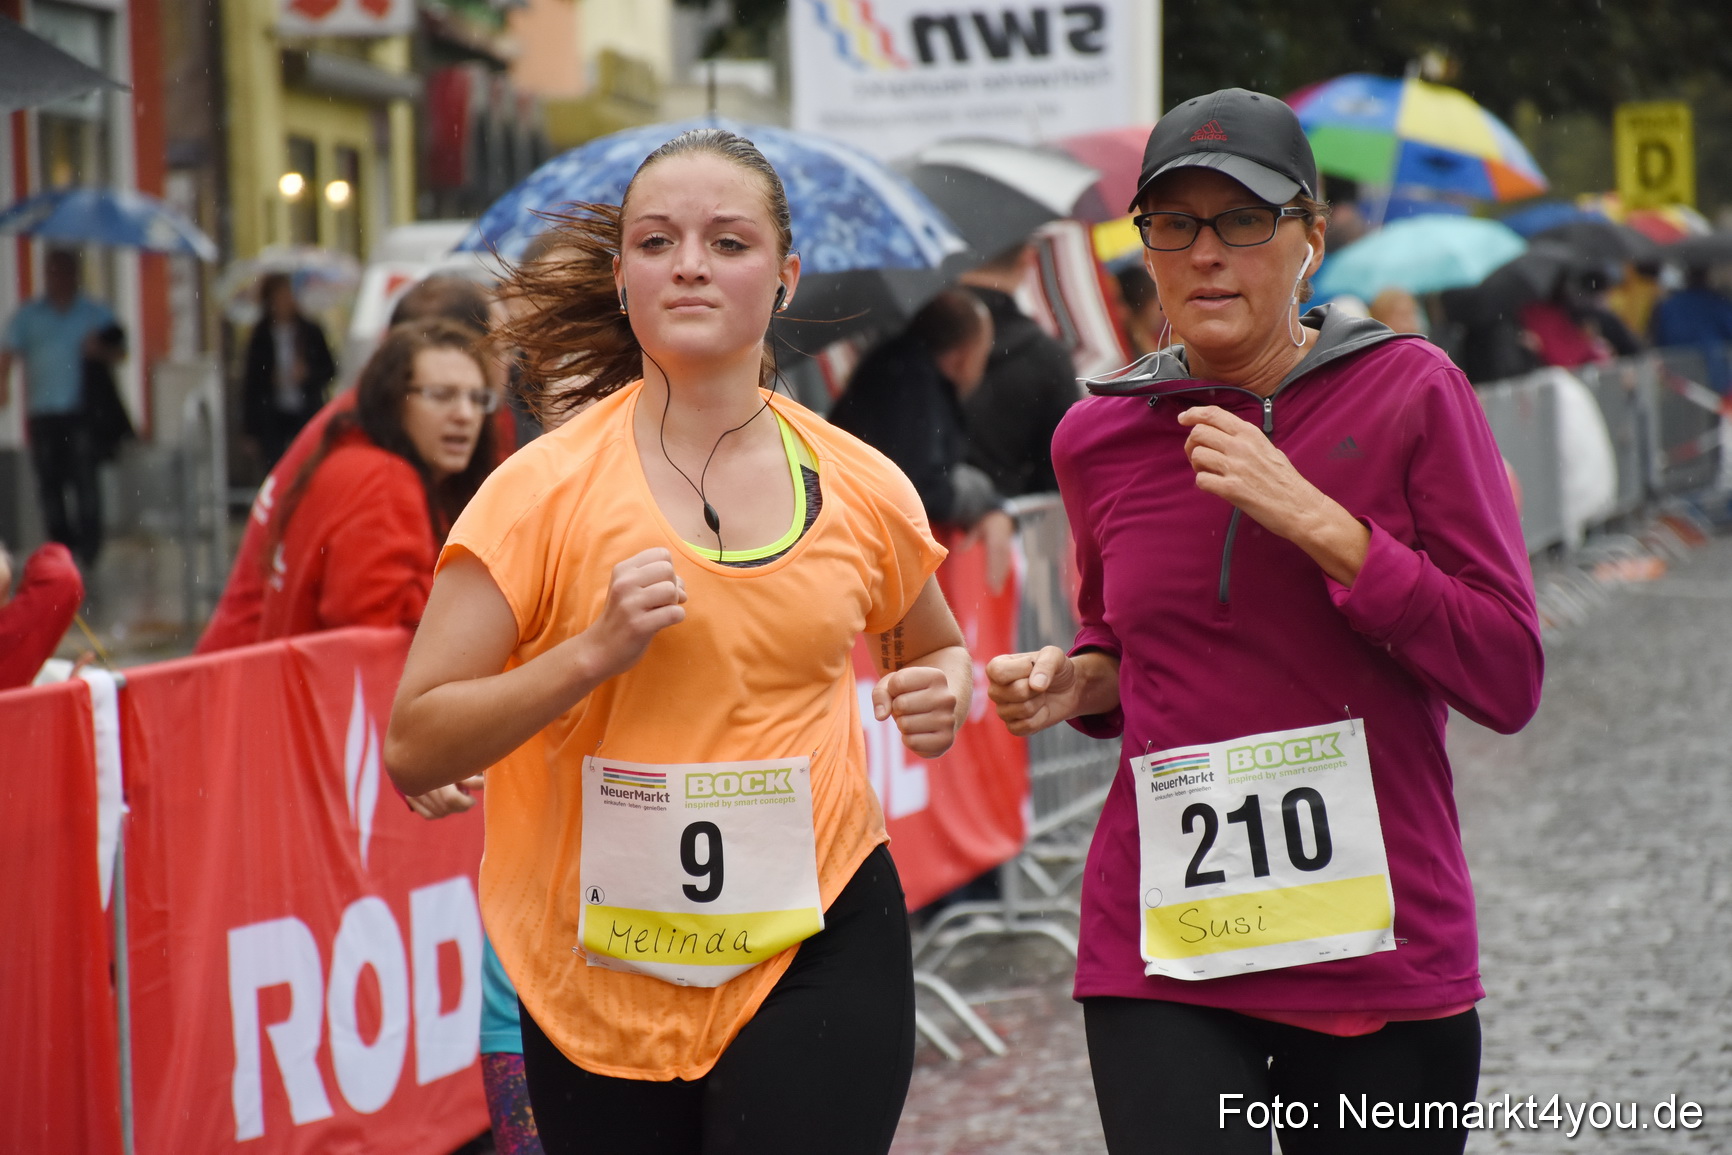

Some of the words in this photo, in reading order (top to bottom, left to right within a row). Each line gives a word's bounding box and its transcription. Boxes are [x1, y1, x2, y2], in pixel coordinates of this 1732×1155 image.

[1189, 133, 1228, 142] adidas
[1227, 731, 1345, 774] BOCK
[685, 768, 794, 799] BOCK
[1151, 771, 1215, 793] NeuerMarkt
[1228, 772, 1263, 784] inspired
[1266, 771, 1277, 780] by
[1279, 767, 1305, 778] smart
[1308, 760, 1348, 773] concepts
[600, 785, 670, 803] NeuerMarkt
[685, 800, 719, 810] inspired
[722, 799, 732, 808] by
[734, 798, 757, 806] smart
[760, 796, 796, 805] concepts
[1181, 786, 1333, 889] 210
[680, 821, 724, 903] 9
[590, 888, 600, 903] A
[607, 920, 753, 954] Melinda
[1178, 905, 1267, 943] Susi
[227, 875, 482, 1142] ROD
